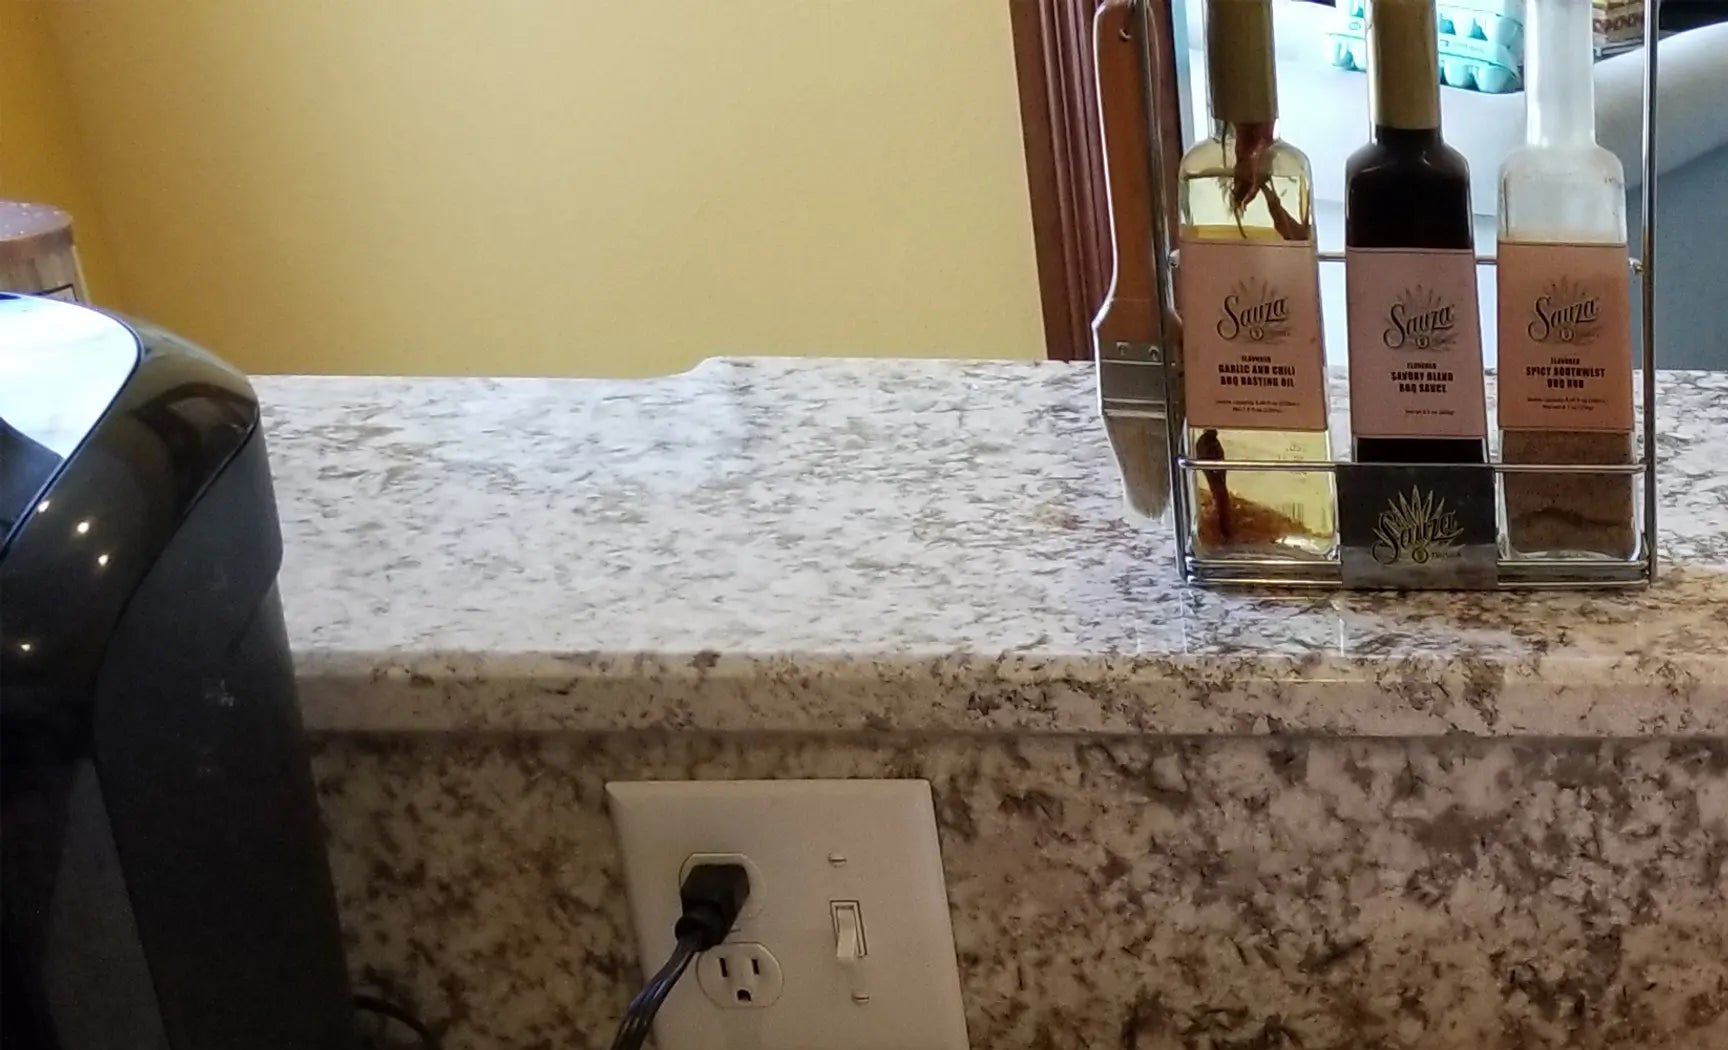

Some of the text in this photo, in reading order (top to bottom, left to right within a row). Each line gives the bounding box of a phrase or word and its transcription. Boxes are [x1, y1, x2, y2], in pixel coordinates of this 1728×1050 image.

[1217, 295, 1289, 341] Sauza
[1527, 297, 1599, 343] Sauza
[1383, 303, 1455, 349] Sauza
[1218, 363, 1296, 376] GARLIC AND CHILI
[1526, 366, 1606, 378] SPICY SOUTHWEST
[1220, 376, 1239, 387] BBQ
[1281, 377, 1295, 388] OIL
[1391, 371, 1454, 382] SAVORY BLEND
[1399, 383, 1447, 394] BBQ SAUCE
[1371, 509, 1457, 566] Sauza
